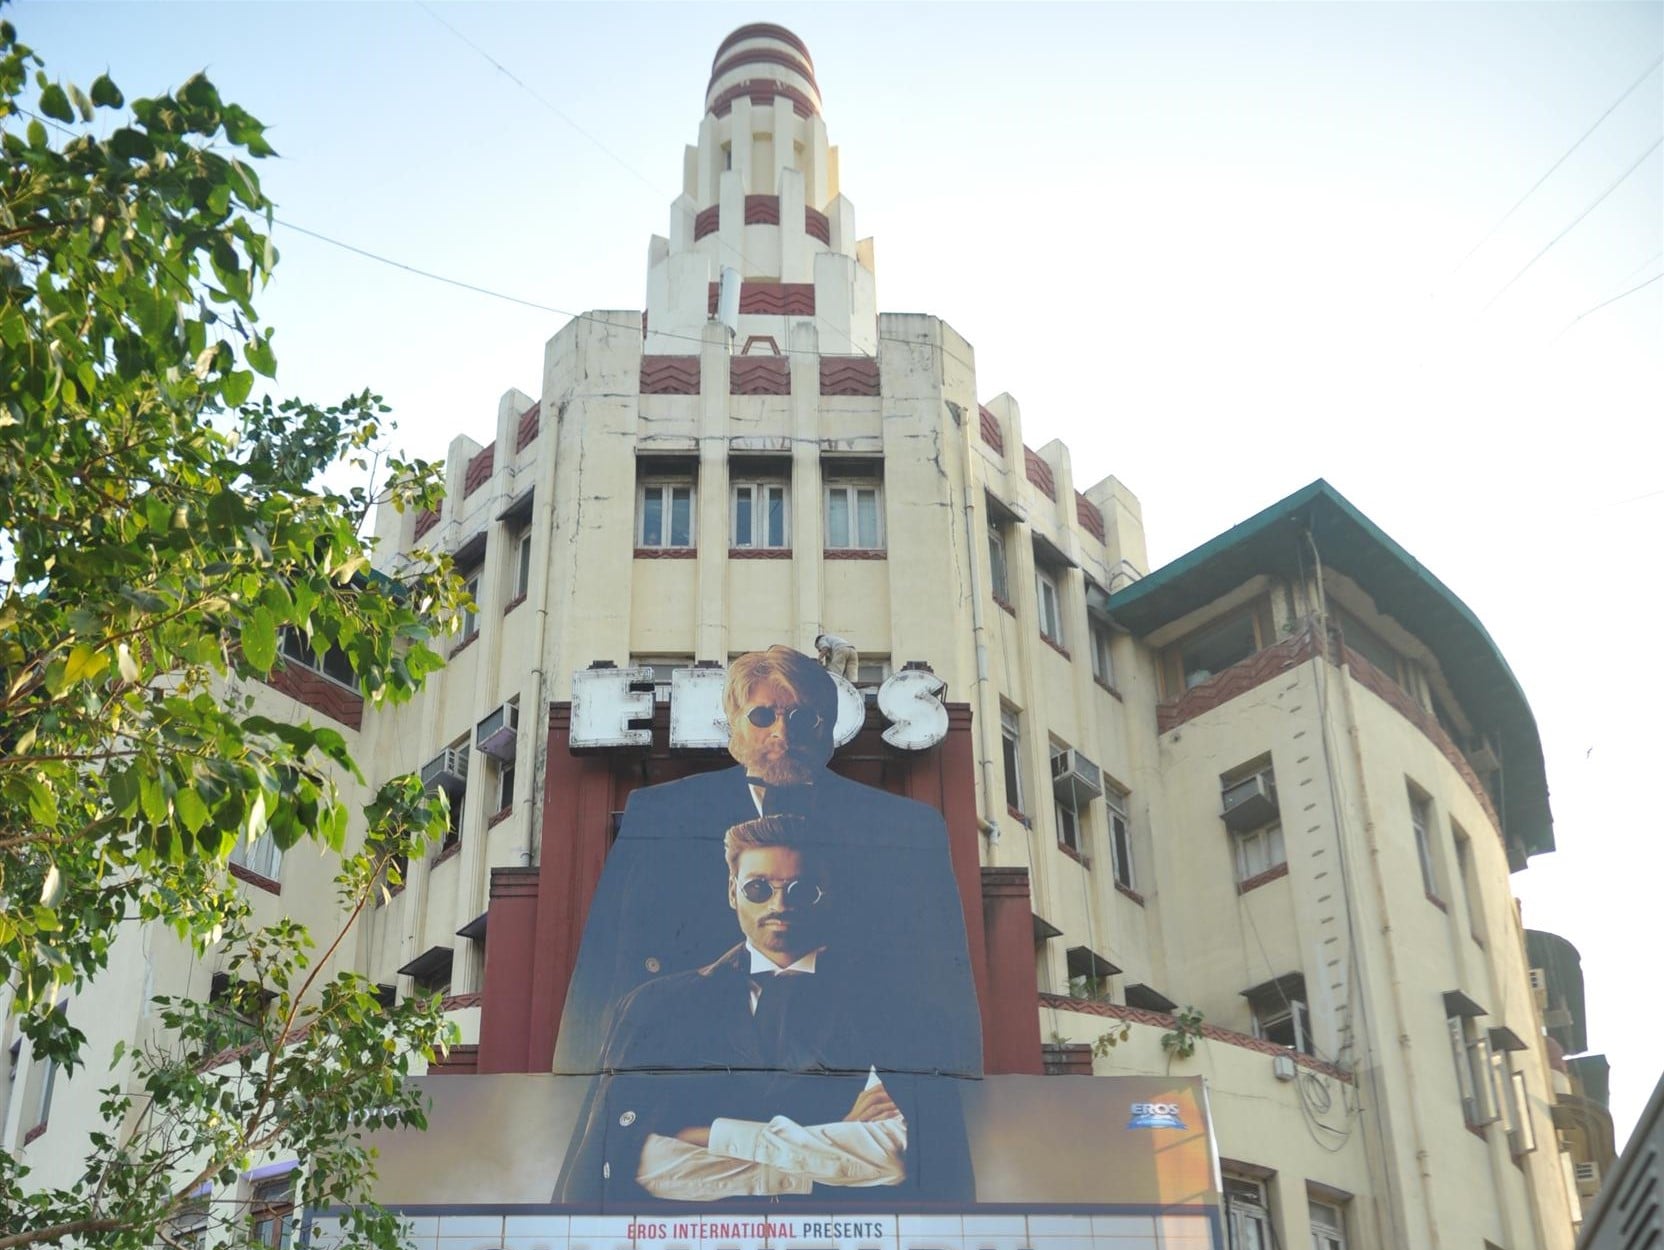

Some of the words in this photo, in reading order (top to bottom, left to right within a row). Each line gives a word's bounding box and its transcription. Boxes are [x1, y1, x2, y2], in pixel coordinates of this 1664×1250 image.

[1130, 1103, 1178, 1115] EROS
[627, 1223, 667, 1239] EROS
[673, 1222, 796, 1239] INTERNATIONAL
[803, 1222, 883, 1238] PRESENTS
